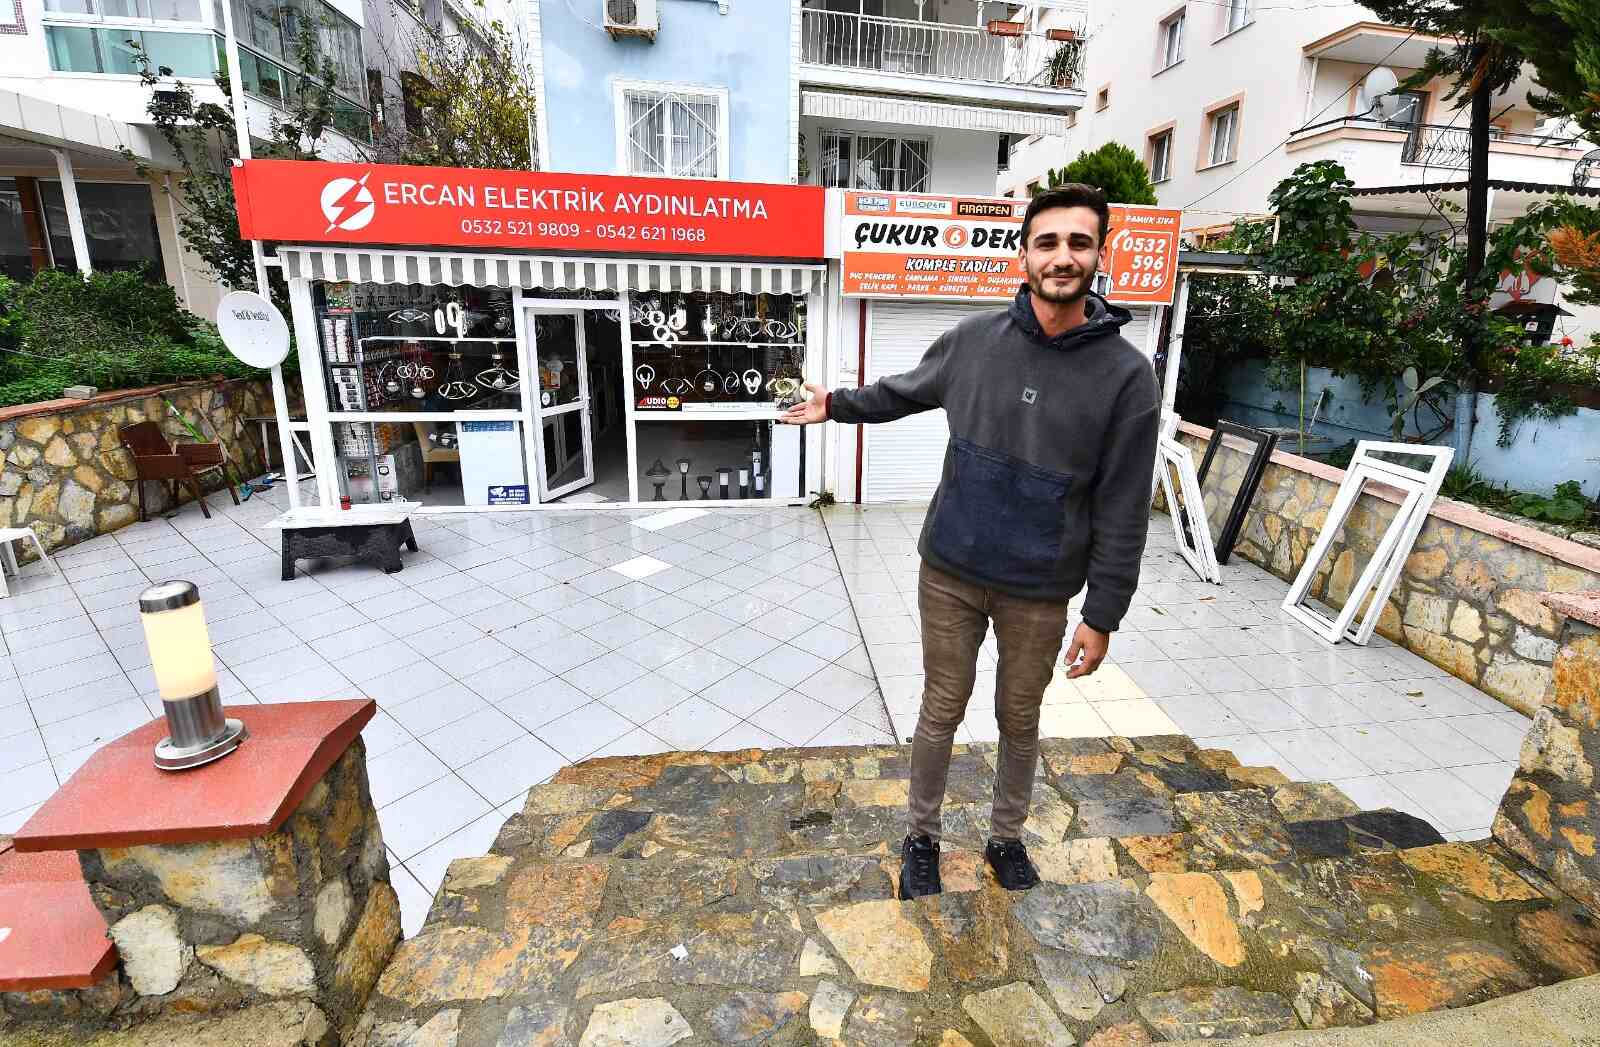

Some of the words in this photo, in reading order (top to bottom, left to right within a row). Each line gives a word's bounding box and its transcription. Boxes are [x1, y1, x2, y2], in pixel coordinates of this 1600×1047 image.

[383, 182, 475, 207] ERCAN
[484, 186, 605, 213] ELEKTRİK
[613, 192, 768, 220] AYDINLATMA
[959, 204, 1010, 216] FIRATPEN
[461, 219, 502, 235] 0532
[507, 221, 533, 236] 521
[538, 222, 580, 237] 9809
[596, 224, 636, 239] 0542
[641, 226, 666, 241] 621
[671, 227, 706, 242] 1968
[855, 222, 939, 249] ÇUKUR
[971, 227, 1022, 251] DEK
[1122, 237, 1167, 254] 0532
[905, 256, 957, 271] KOMPLE
[960, 257, 1009, 273] TADİLAT
[1131, 254, 1164, 271] 596
[1118, 271, 1163, 288] 8186
